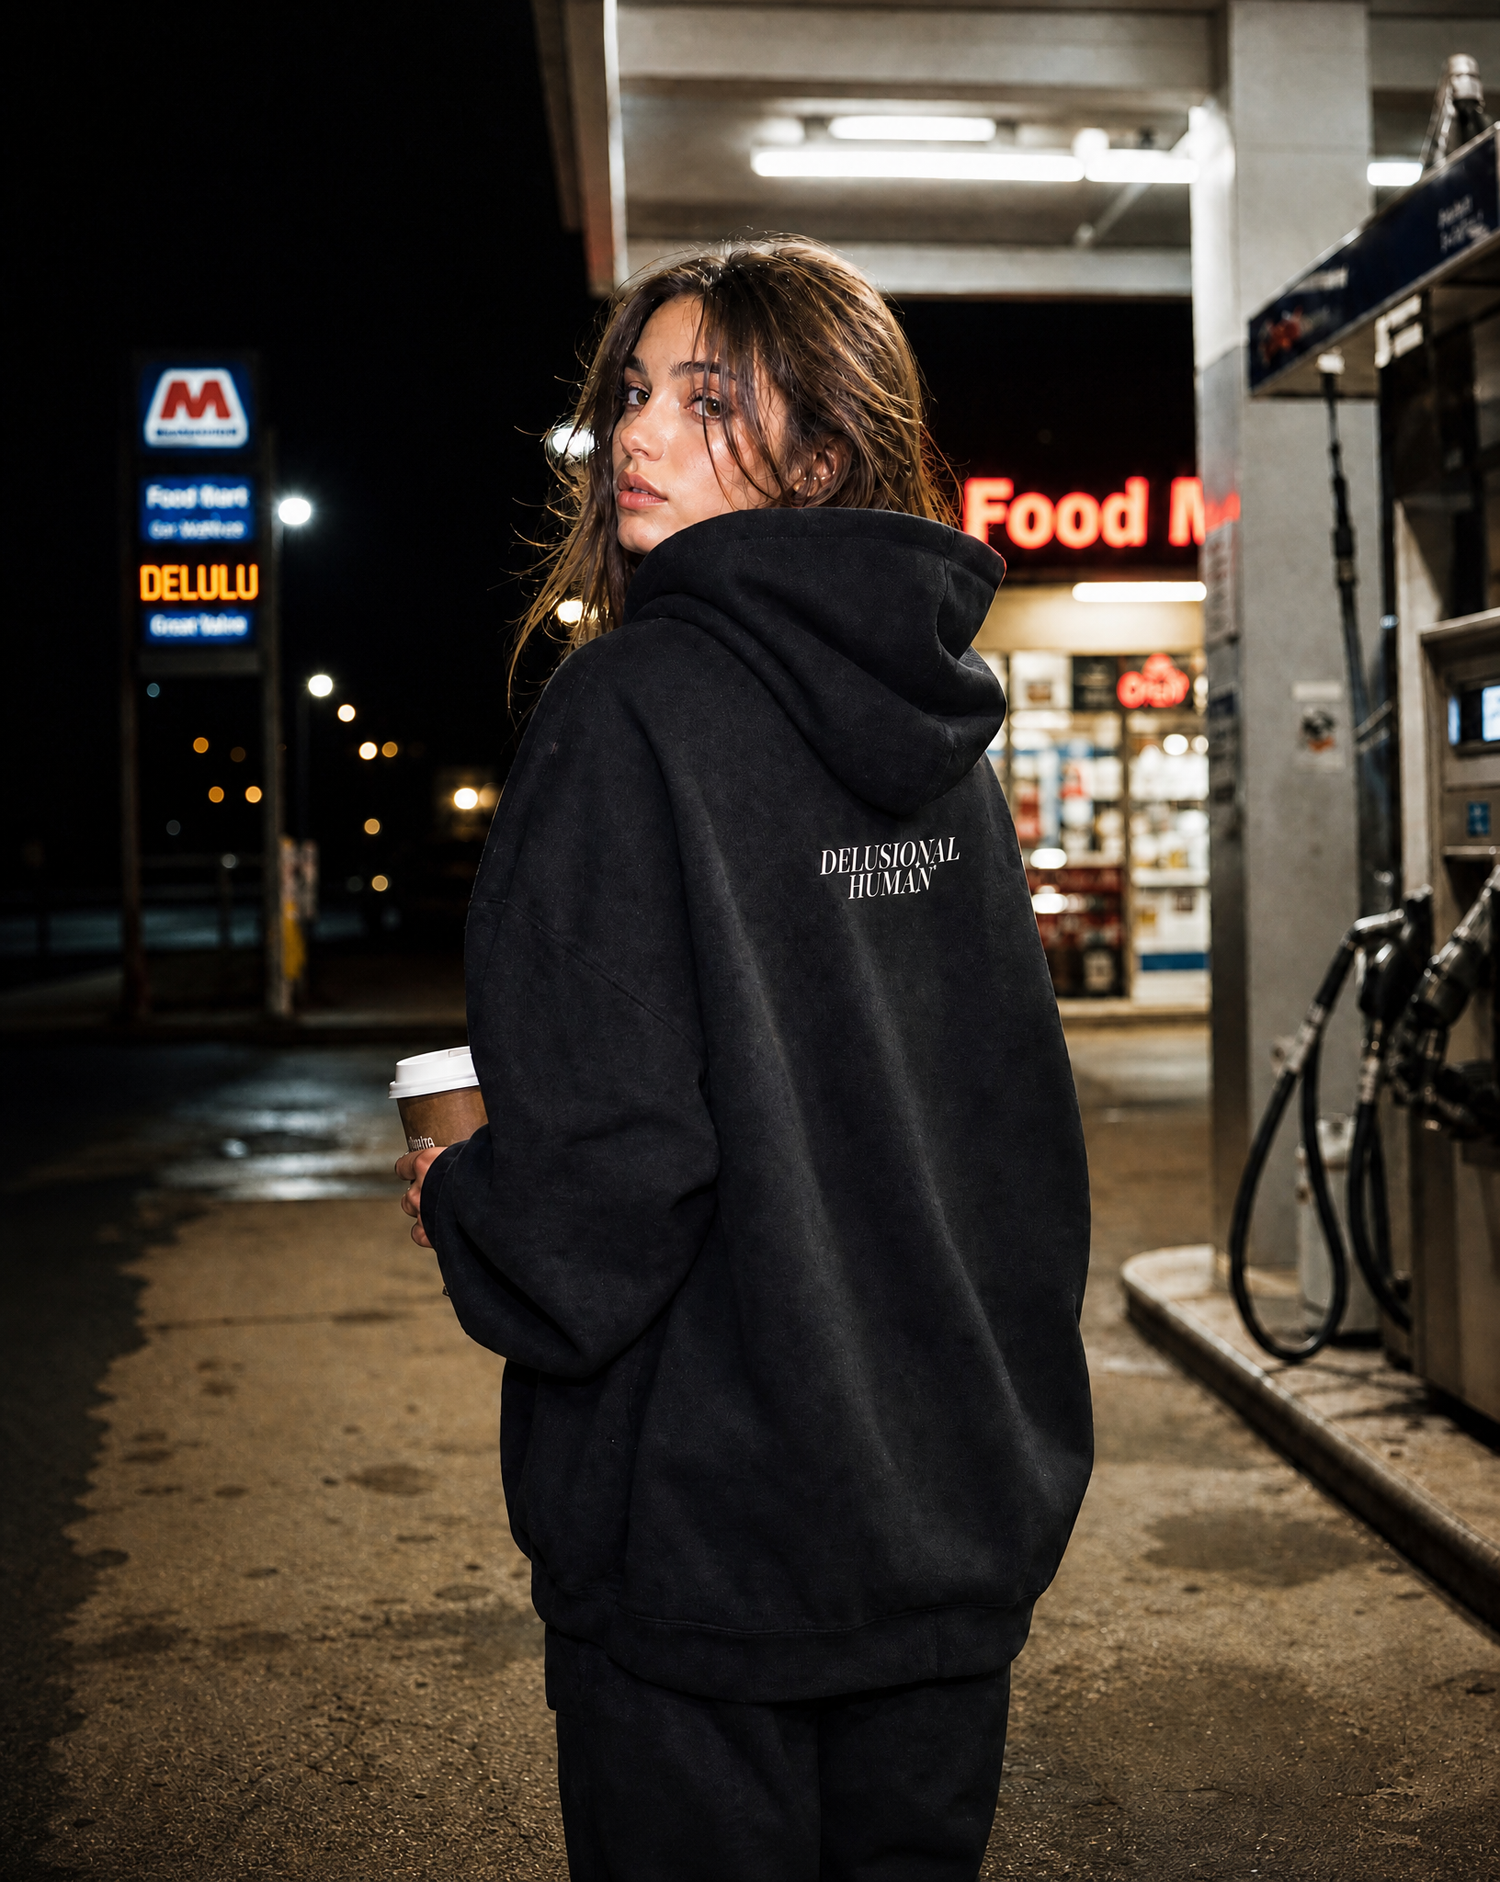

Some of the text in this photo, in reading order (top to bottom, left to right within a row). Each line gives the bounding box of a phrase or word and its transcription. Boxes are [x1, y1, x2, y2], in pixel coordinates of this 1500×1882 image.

[160, 379, 231, 420] M
[146, 484, 197, 509] Food
[964, 476, 1149, 549] Food
[140, 564, 259, 601] DELULU
[820, 836, 960, 876] DELUSIONAL
[848, 866, 934, 900] HUMAN
